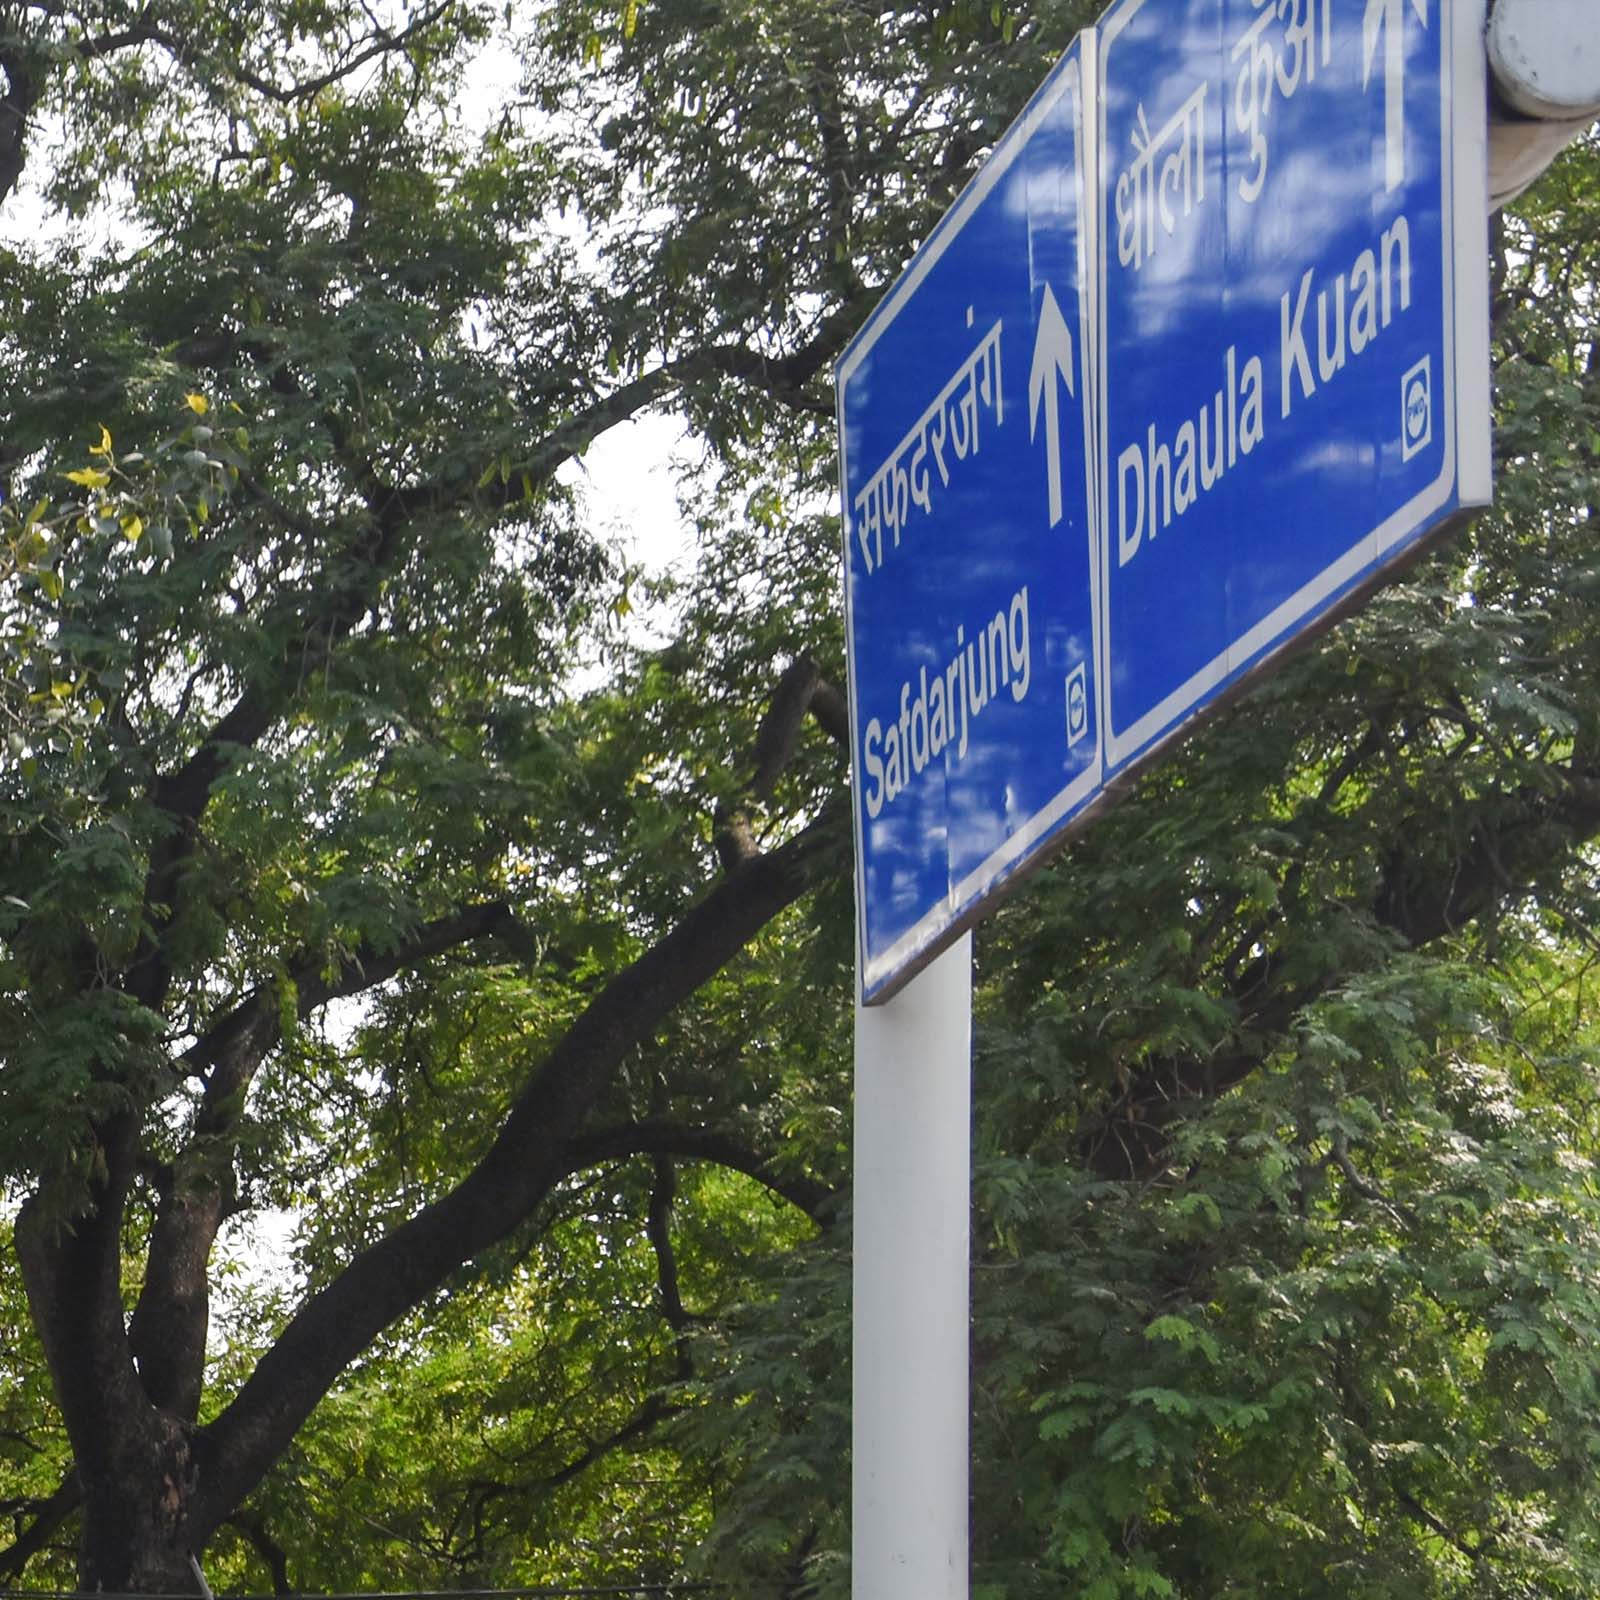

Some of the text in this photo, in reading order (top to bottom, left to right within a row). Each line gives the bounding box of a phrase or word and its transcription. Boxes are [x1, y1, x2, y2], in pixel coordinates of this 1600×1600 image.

[1116, 80, 1208, 271] धौला
[853, 306, 1006, 575] सफदरजंग
[1116, 215, 1412, 569] Dhaula Kuan
[863, 584, 1031, 820] Safdarjung
